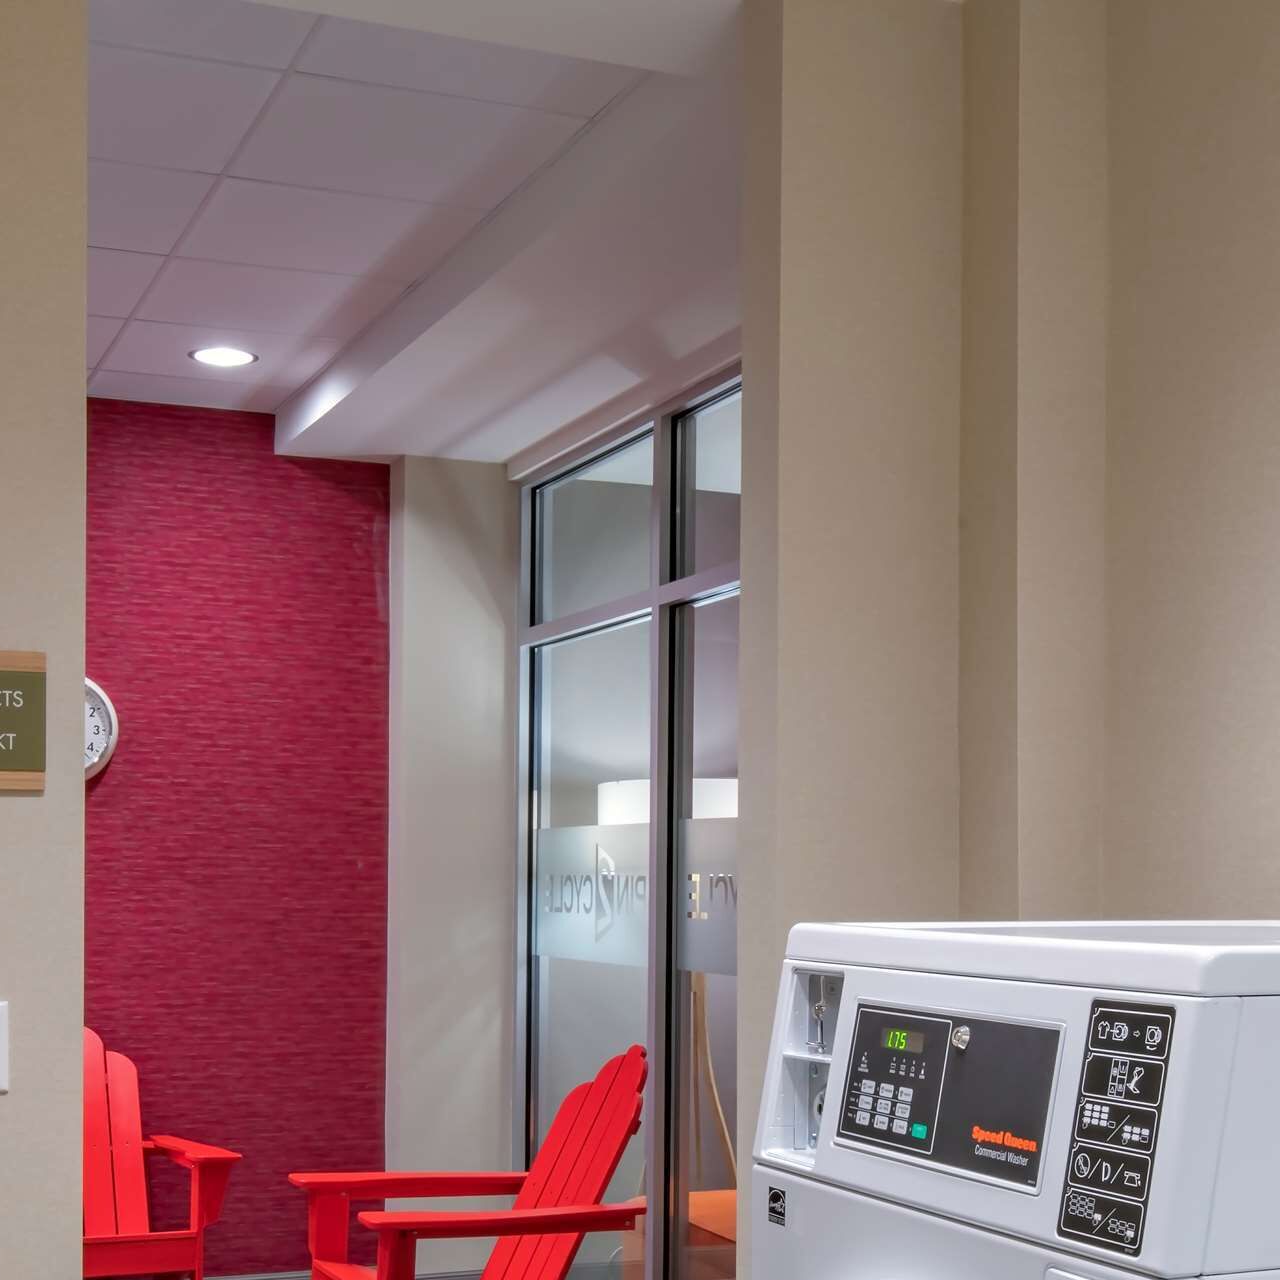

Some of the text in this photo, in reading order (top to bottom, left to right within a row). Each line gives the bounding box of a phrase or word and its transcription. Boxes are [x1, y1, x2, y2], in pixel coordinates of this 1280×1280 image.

[89, 707, 96, 717] 2
[93, 725, 100, 736] 3
[87, 742, 94, 752] 4
[972, 1126, 1037, 1152] Speed Queen
[974, 1144, 1029, 1166] Commercial Washer
